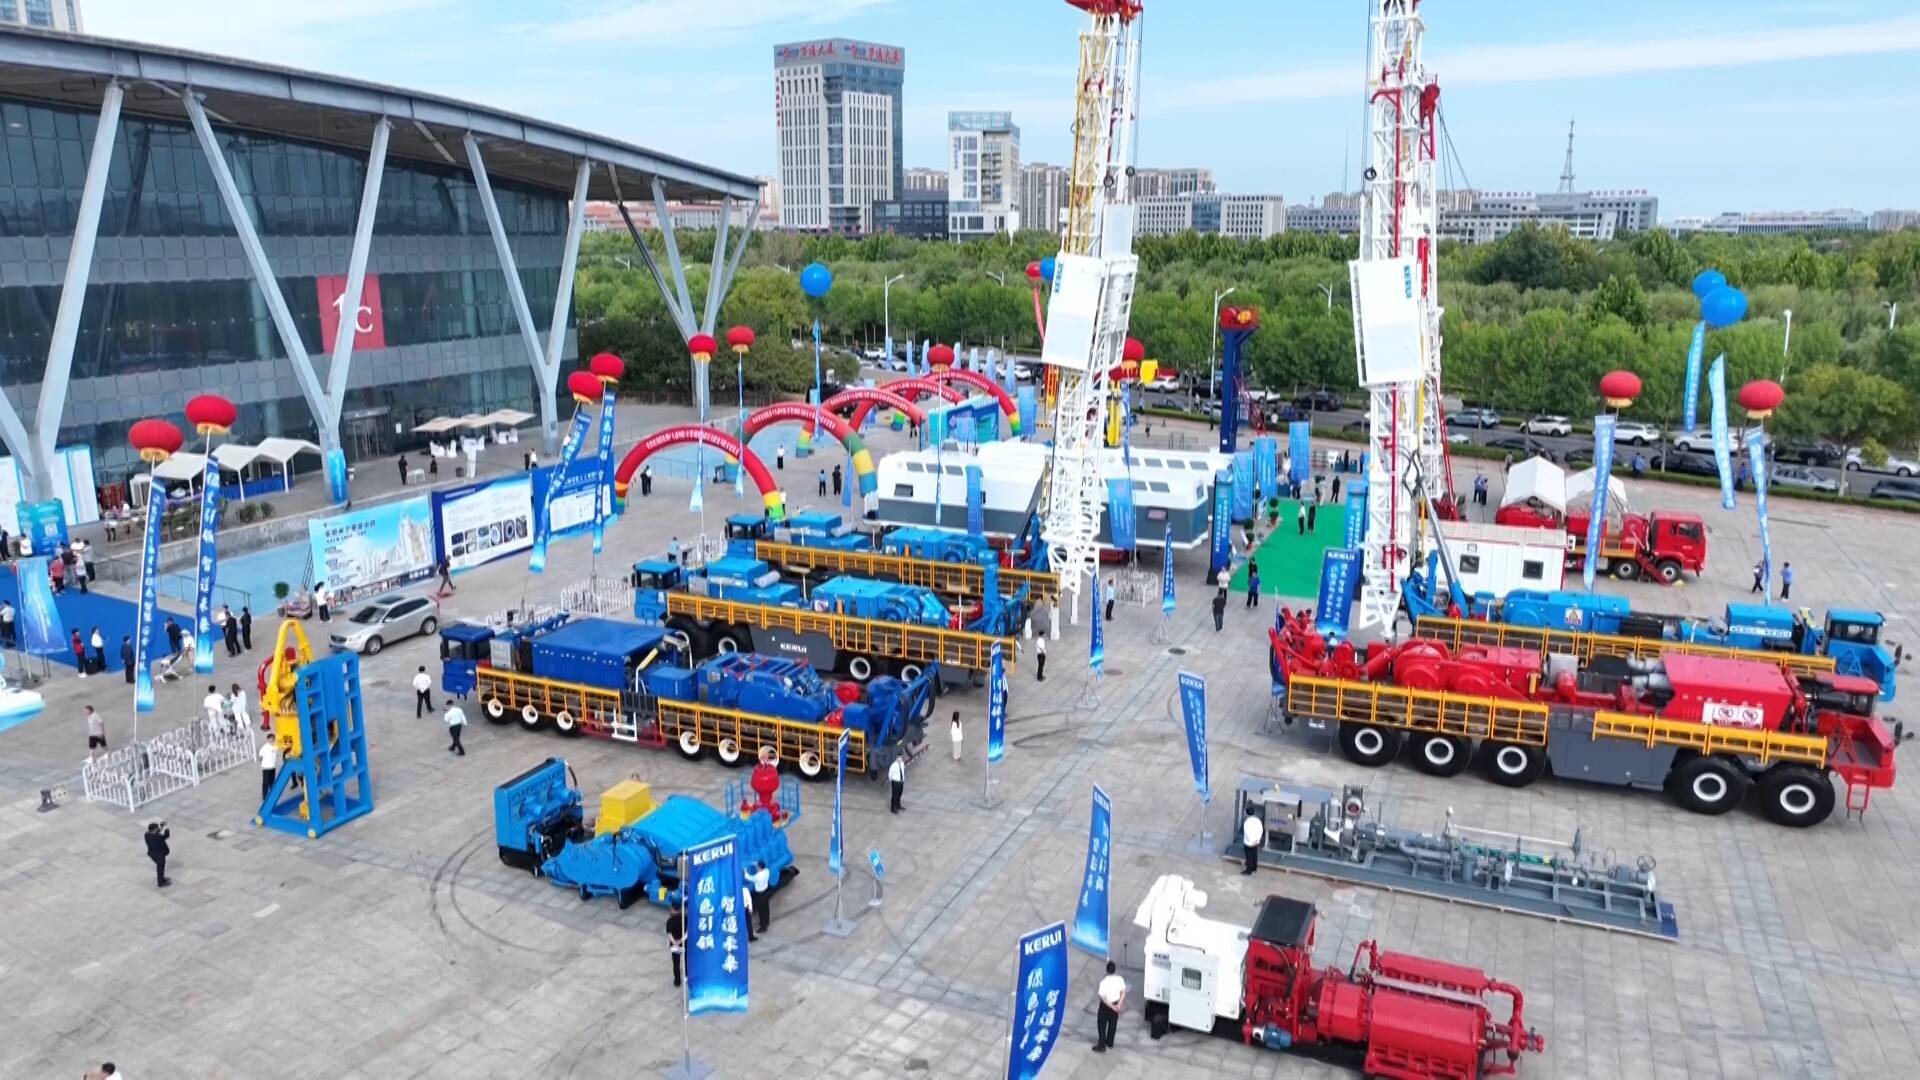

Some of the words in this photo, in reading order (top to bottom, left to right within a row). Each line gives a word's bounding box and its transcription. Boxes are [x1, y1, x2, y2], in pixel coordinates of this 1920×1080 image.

[693, 841, 734, 866] KERUI
[697, 875, 715, 950] 绿色引领
[1024, 929, 1062, 956] KERUI
